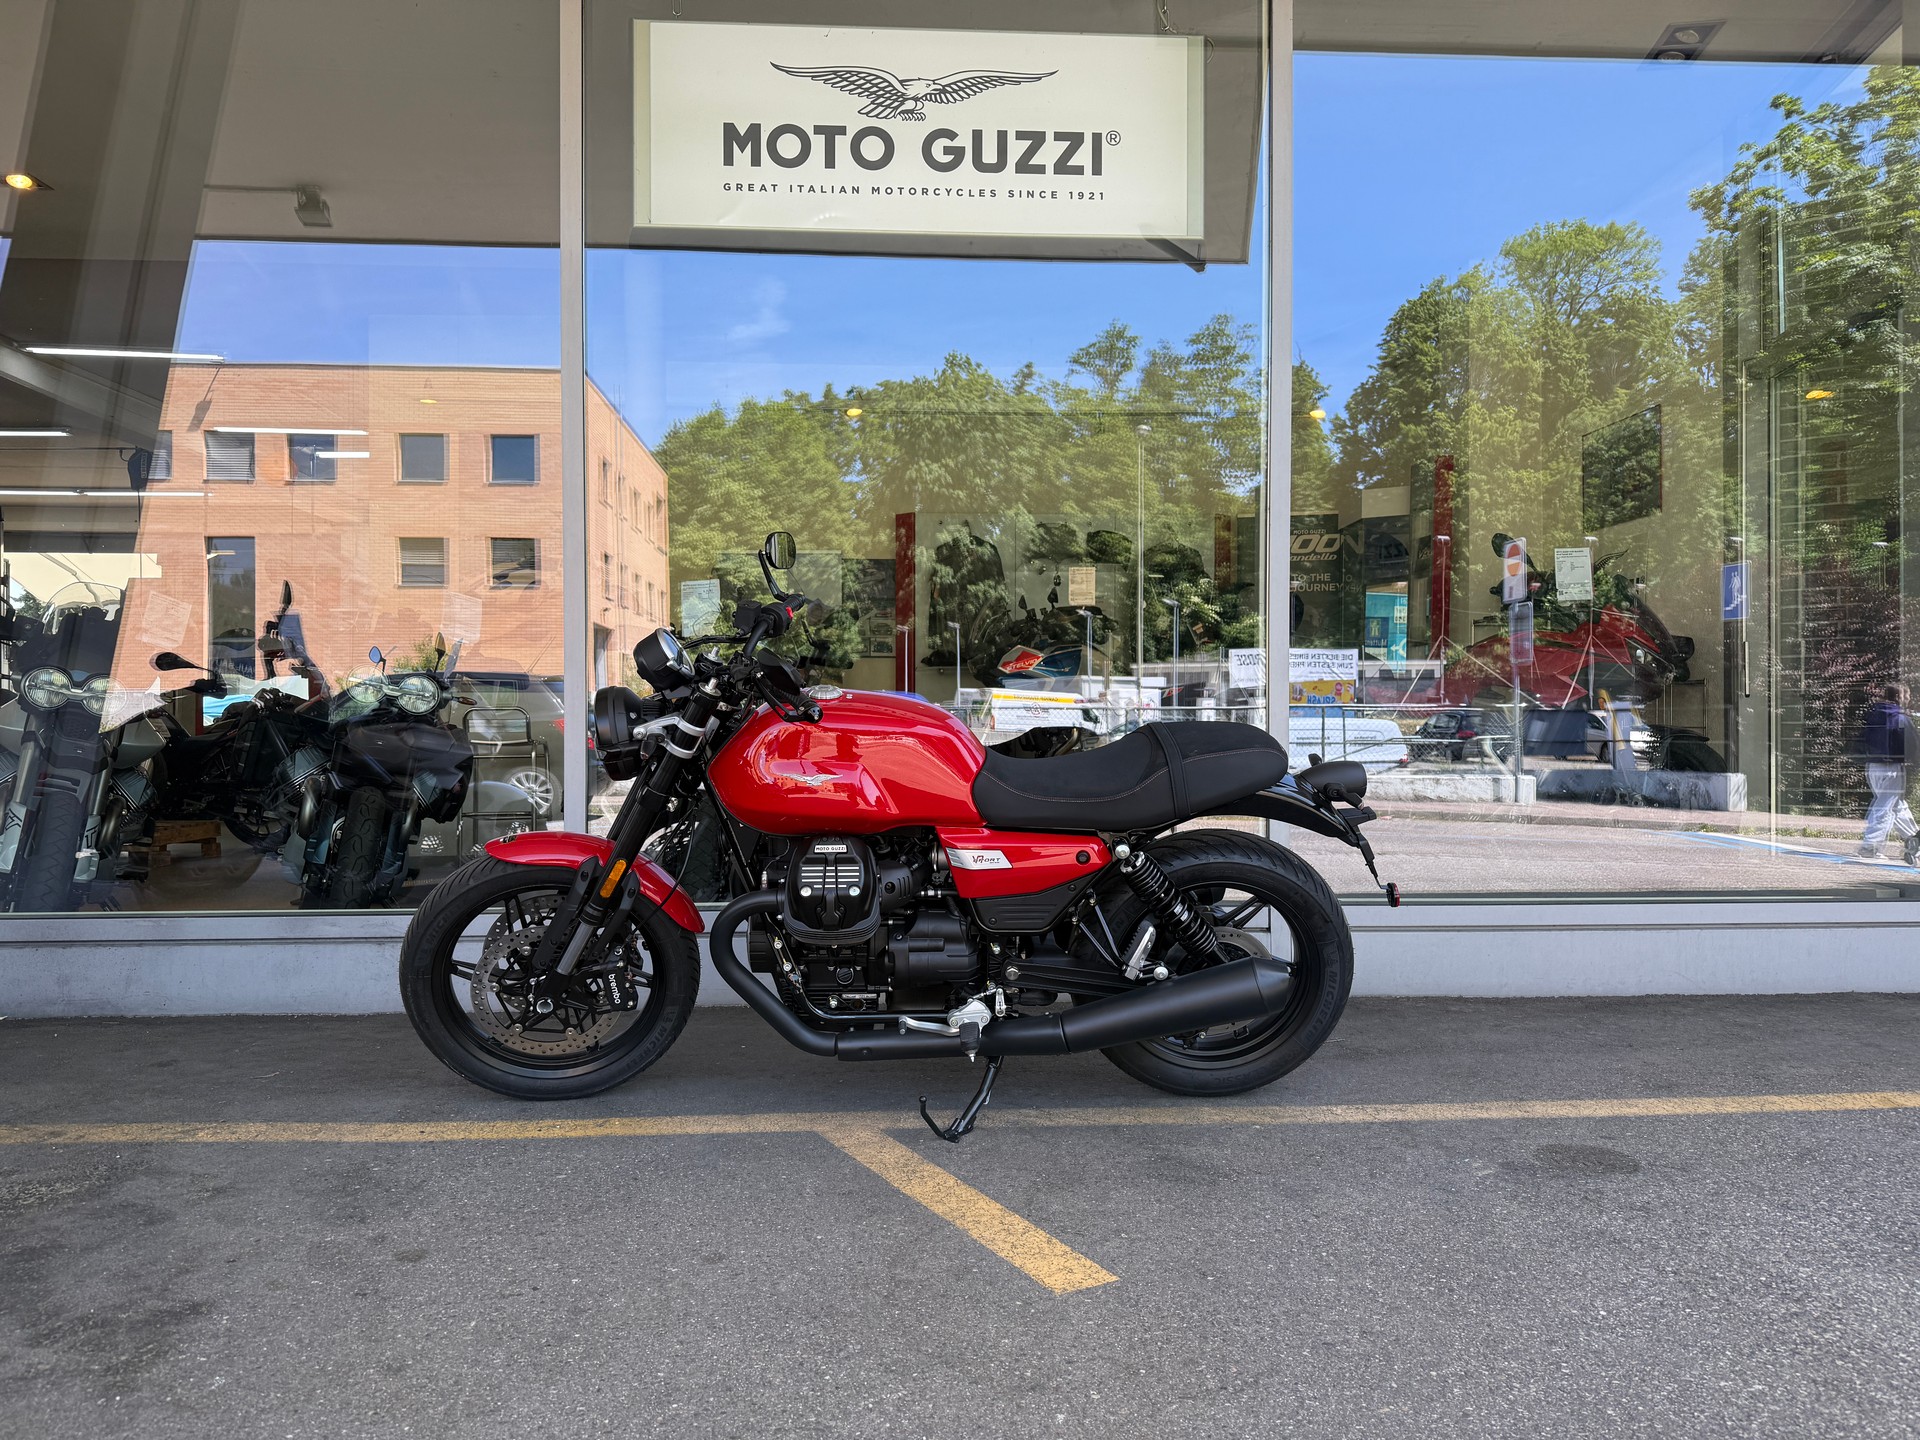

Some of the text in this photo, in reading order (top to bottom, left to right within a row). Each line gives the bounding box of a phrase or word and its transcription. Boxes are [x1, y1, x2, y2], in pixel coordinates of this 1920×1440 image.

[722, 121, 895, 171] MOTO
[723, 182, 1105, 201] GREAT ITALIAN MOTORCYCLES SINCE 1921
[1290, 553, 1338, 562] andello
[1291, 573, 1332, 582] TO THE
[1006, 658, 1038, 670] STELVIO
[608, 973, 621, 1004] brembo
